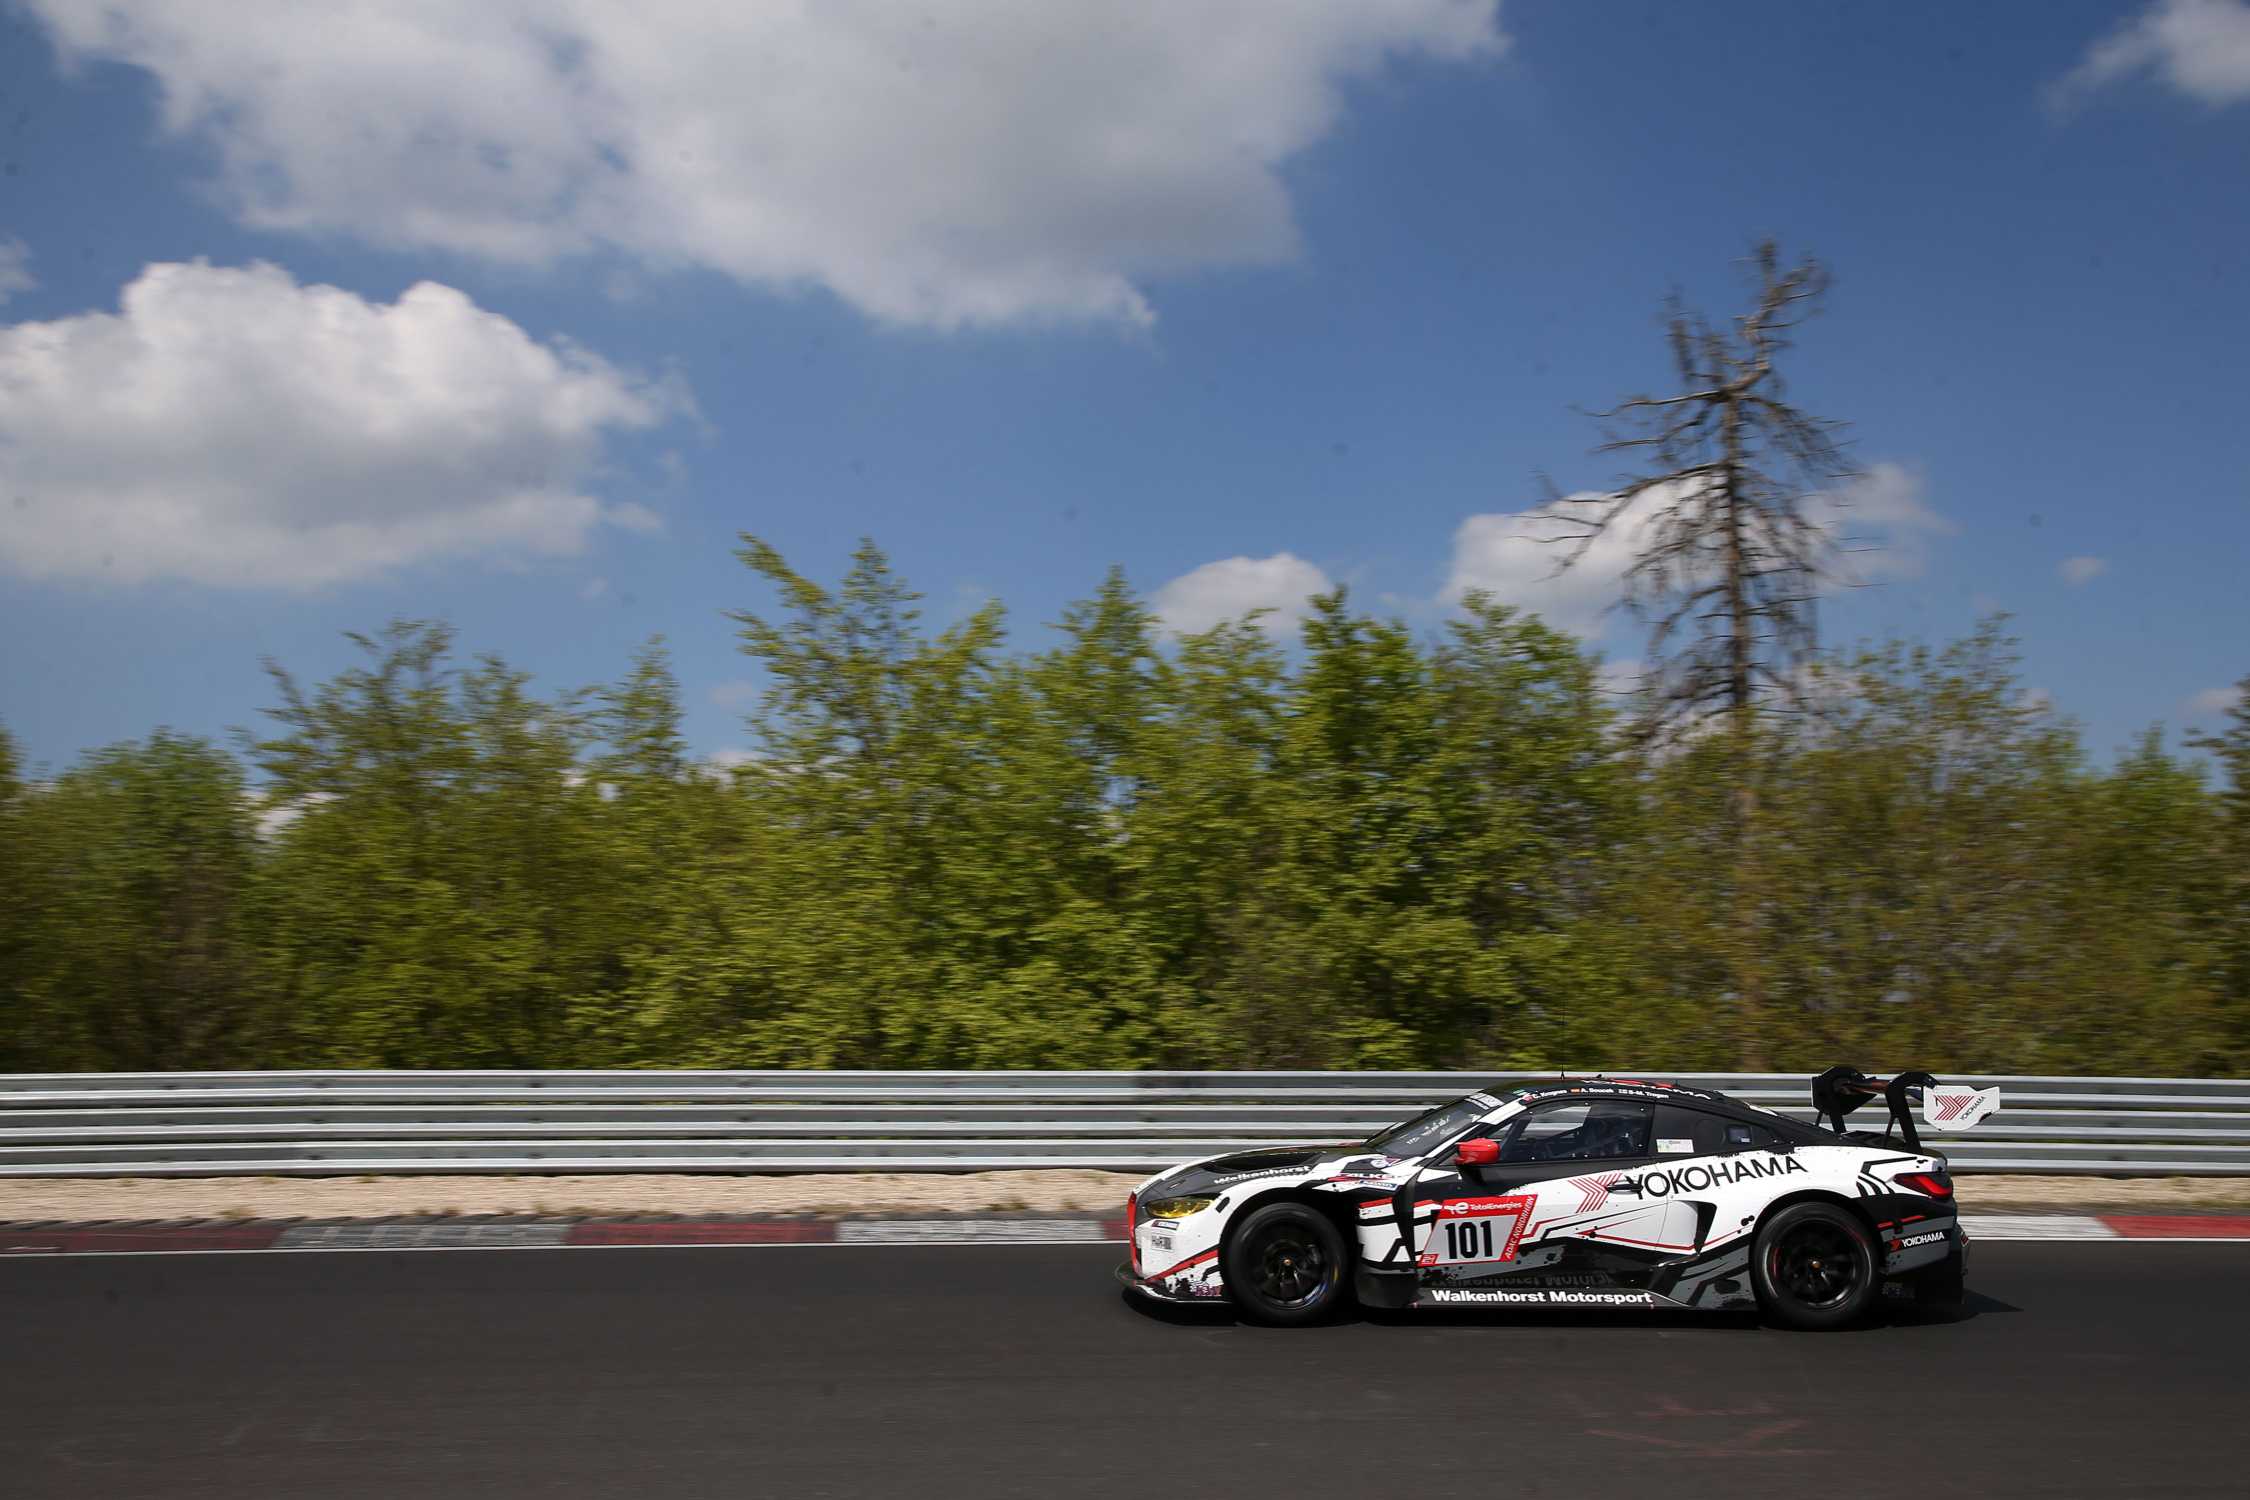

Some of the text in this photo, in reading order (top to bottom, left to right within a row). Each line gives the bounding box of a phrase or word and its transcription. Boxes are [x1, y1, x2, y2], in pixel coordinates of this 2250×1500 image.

[1959, 1096, 1986, 1121] YOKOHAMA
[1625, 1155, 1809, 1200] YOKOHAMA
[1470, 1201, 1523, 1212] TotalEnergies
[1445, 1220, 1493, 1260] 101
[1505, 1195, 1535, 1260] ADAC NORDRHEIN
[1902, 1231, 1945, 1248] YOKOHAMA
[1431, 1290, 1654, 1305] Walkenhorst Motorsport
